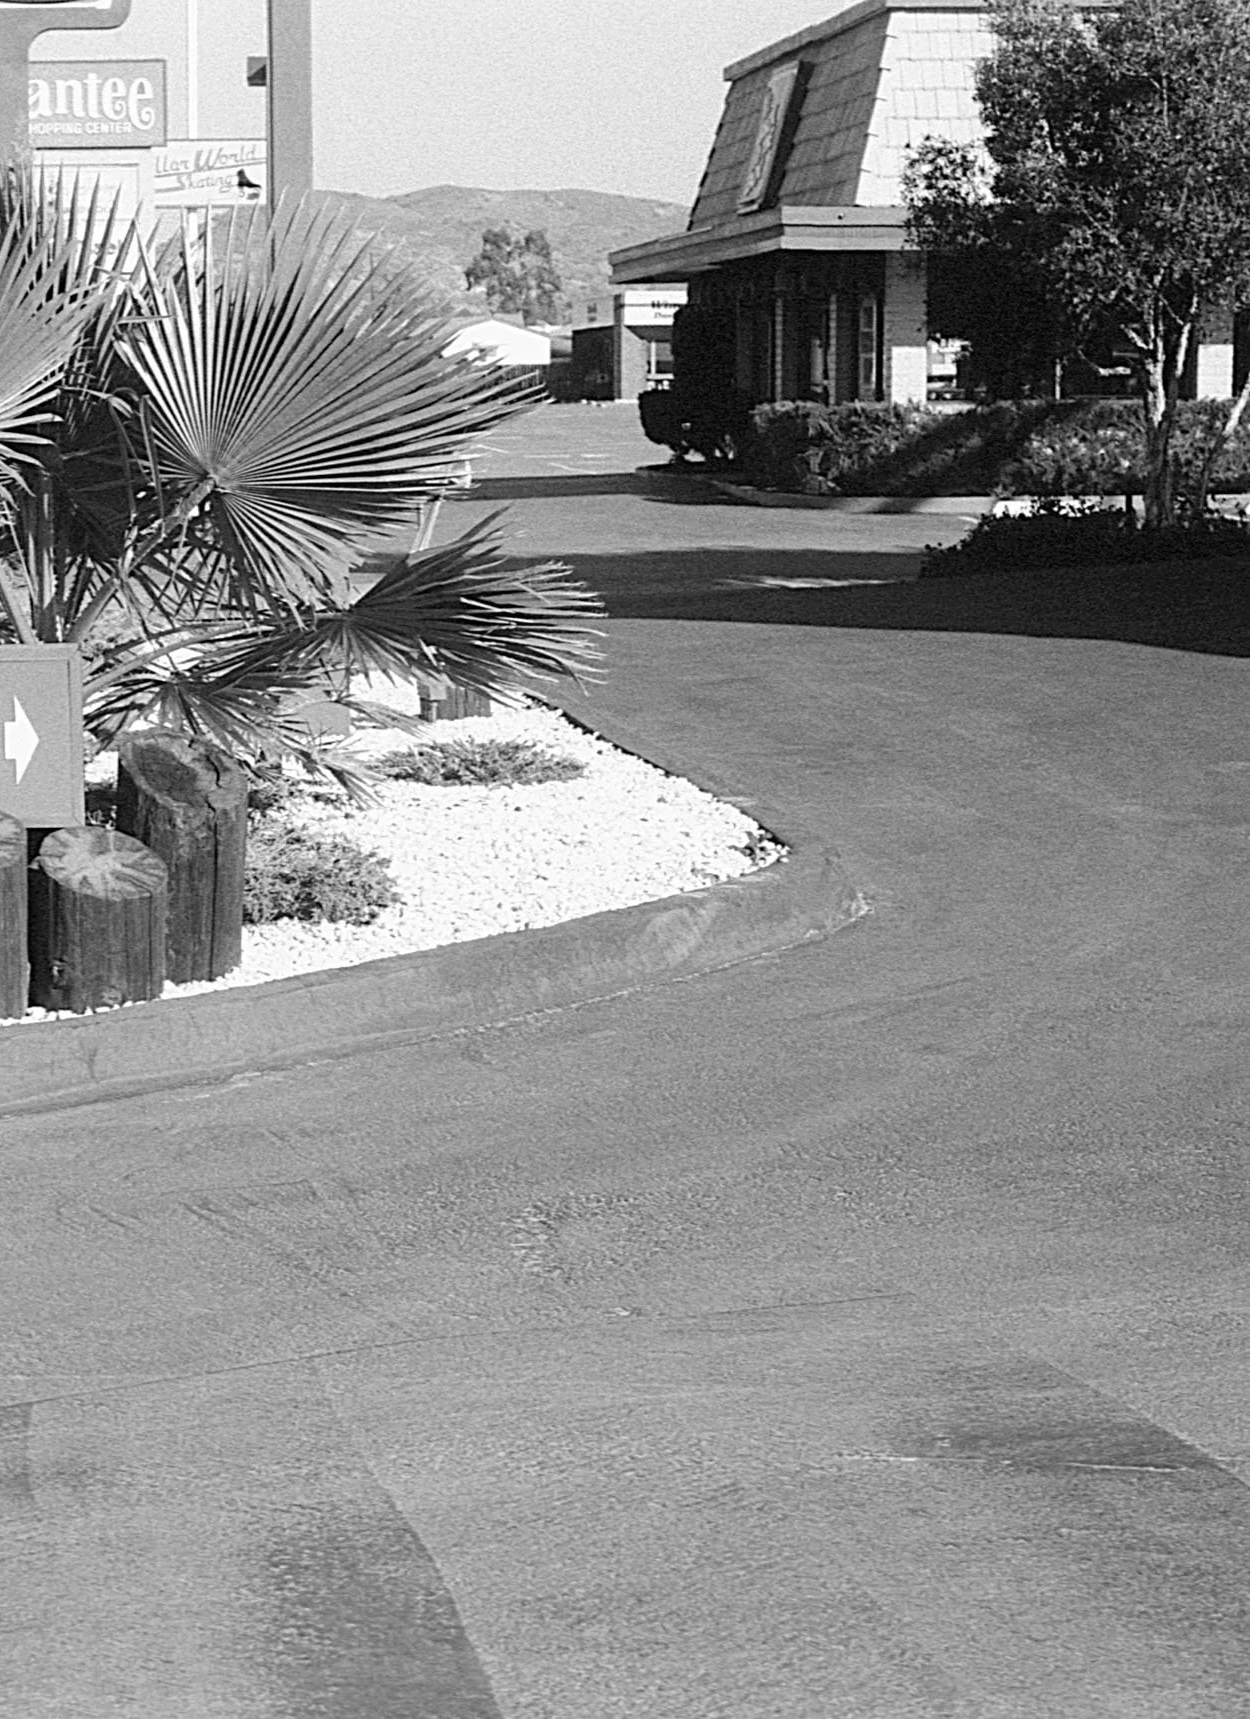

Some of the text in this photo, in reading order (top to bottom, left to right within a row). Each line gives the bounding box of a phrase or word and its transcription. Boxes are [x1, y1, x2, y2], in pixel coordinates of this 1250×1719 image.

[28, 122, 131, 135] HOPPING CENTER
[194, 144, 257, 172] World
